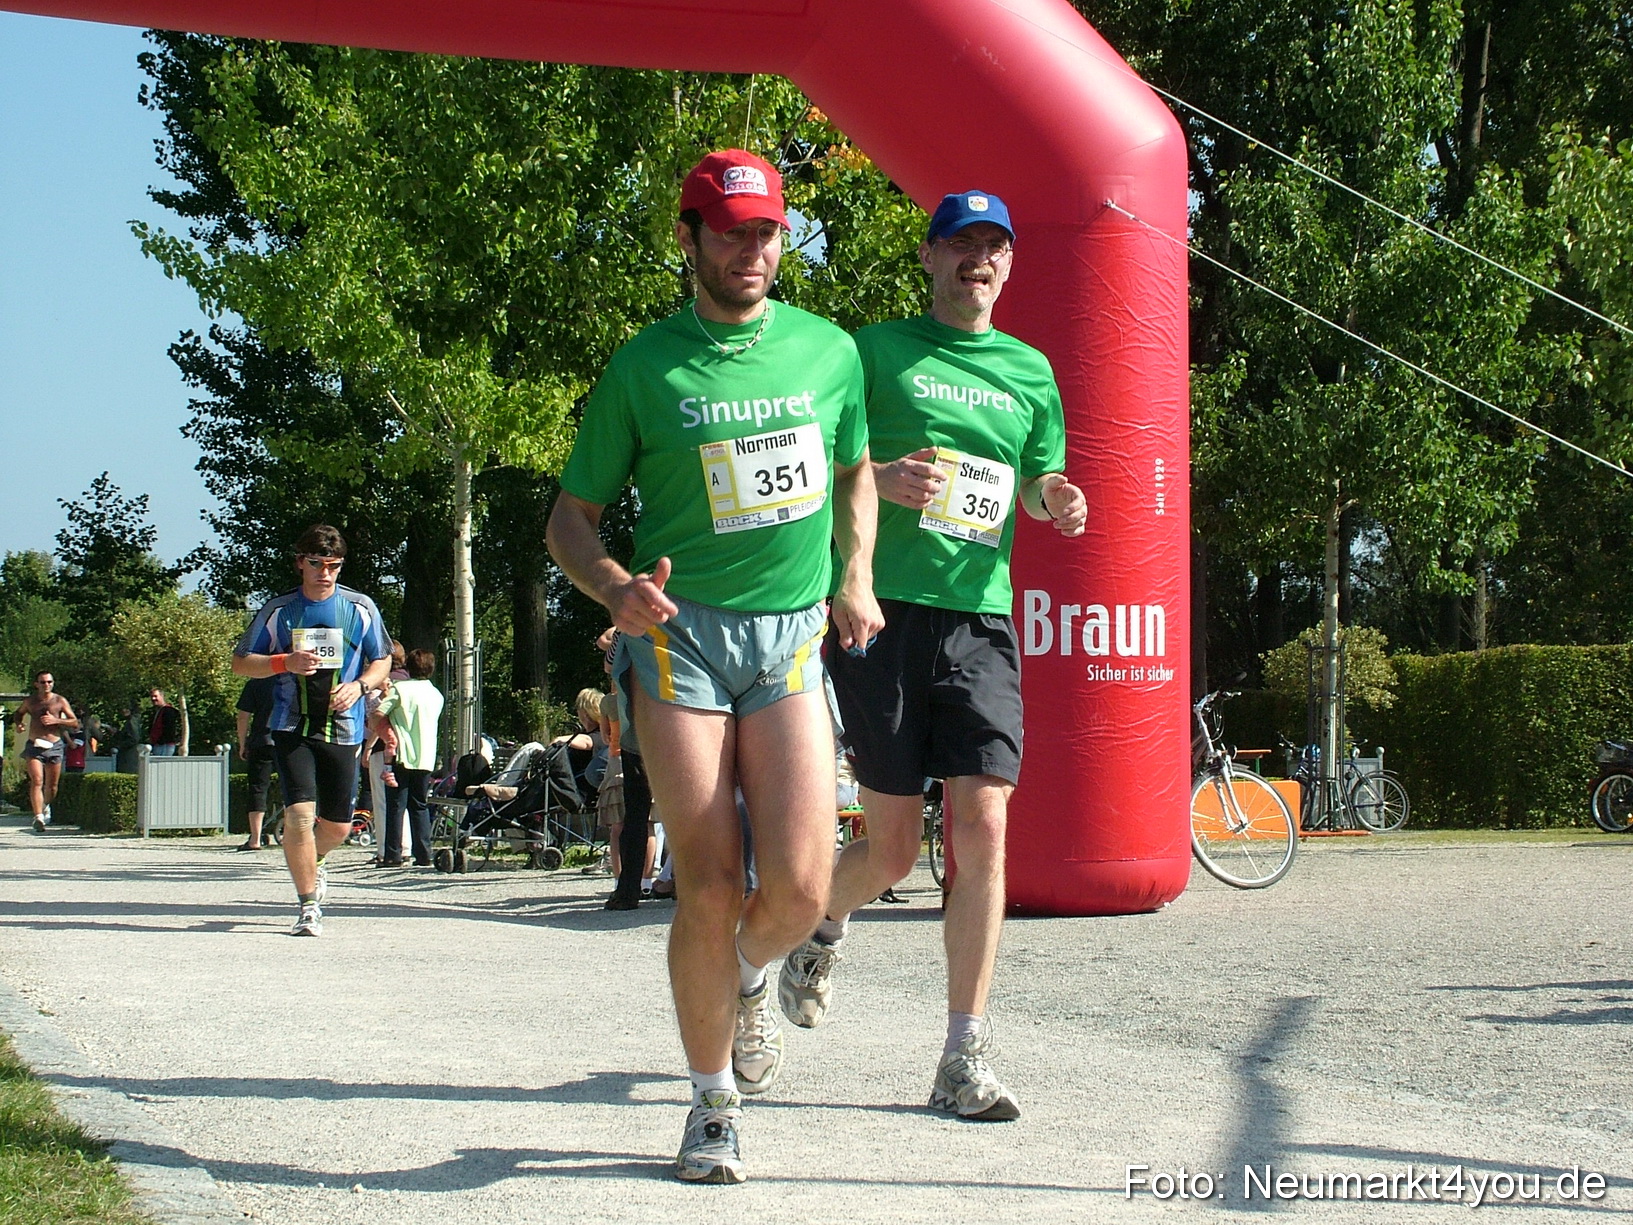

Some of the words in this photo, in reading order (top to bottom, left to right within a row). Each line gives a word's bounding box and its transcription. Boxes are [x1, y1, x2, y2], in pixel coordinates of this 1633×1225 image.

[912, 374, 1014, 412] Sinupret
[735, 432, 797, 455] Norman
[712, 472, 720, 487] A
[755, 461, 808, 496] 351
[960, 462, 999, 486] Steffen
[1155, 458, 1165, 487] 1929
[962, 493, 999, 521] 350
[716, 512, 763, 529] BOCK
[1023, 589, 1166, 656] Braun
[1087, 663, 1126, 681] Sicher
[1130, 665, 1144, 681] ist
[1147, 663, 1174, 681] sicher
